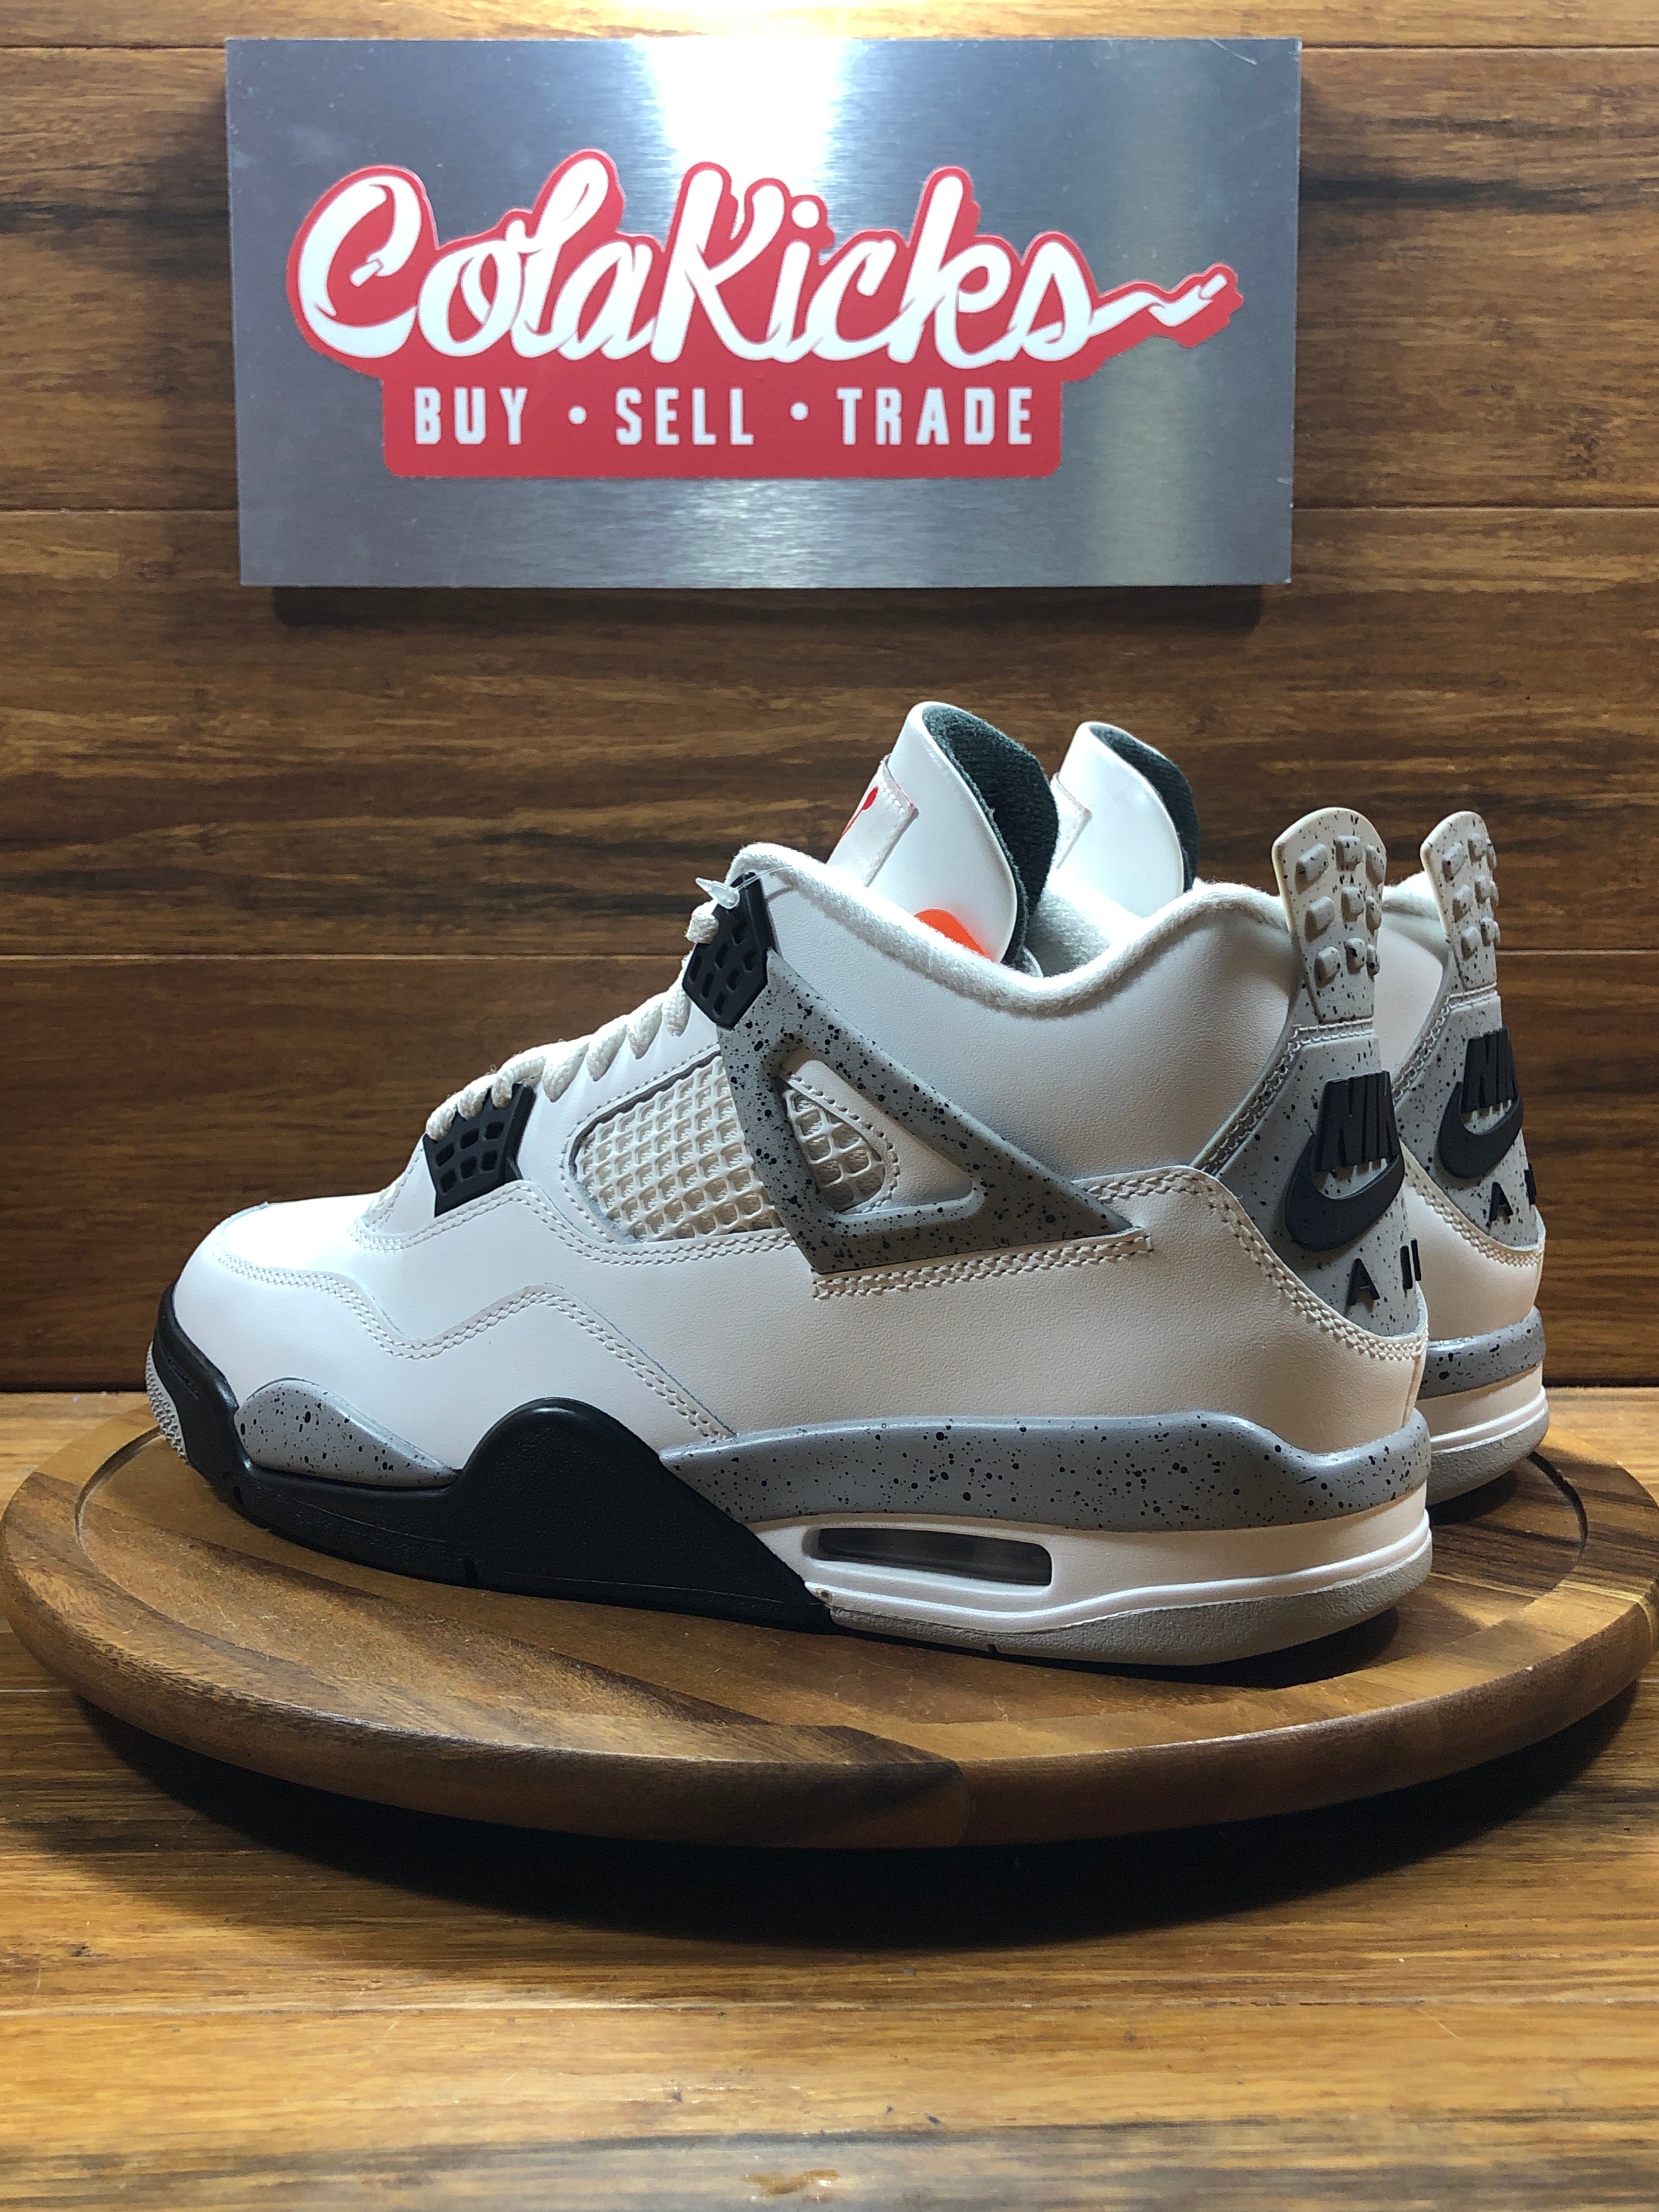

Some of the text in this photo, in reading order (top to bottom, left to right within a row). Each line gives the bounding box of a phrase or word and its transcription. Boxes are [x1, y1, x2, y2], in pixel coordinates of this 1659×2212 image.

[298, 157, 1227, 369] ColaKicks
[414, 386, 1032, 445] BUY SELL TRADE
